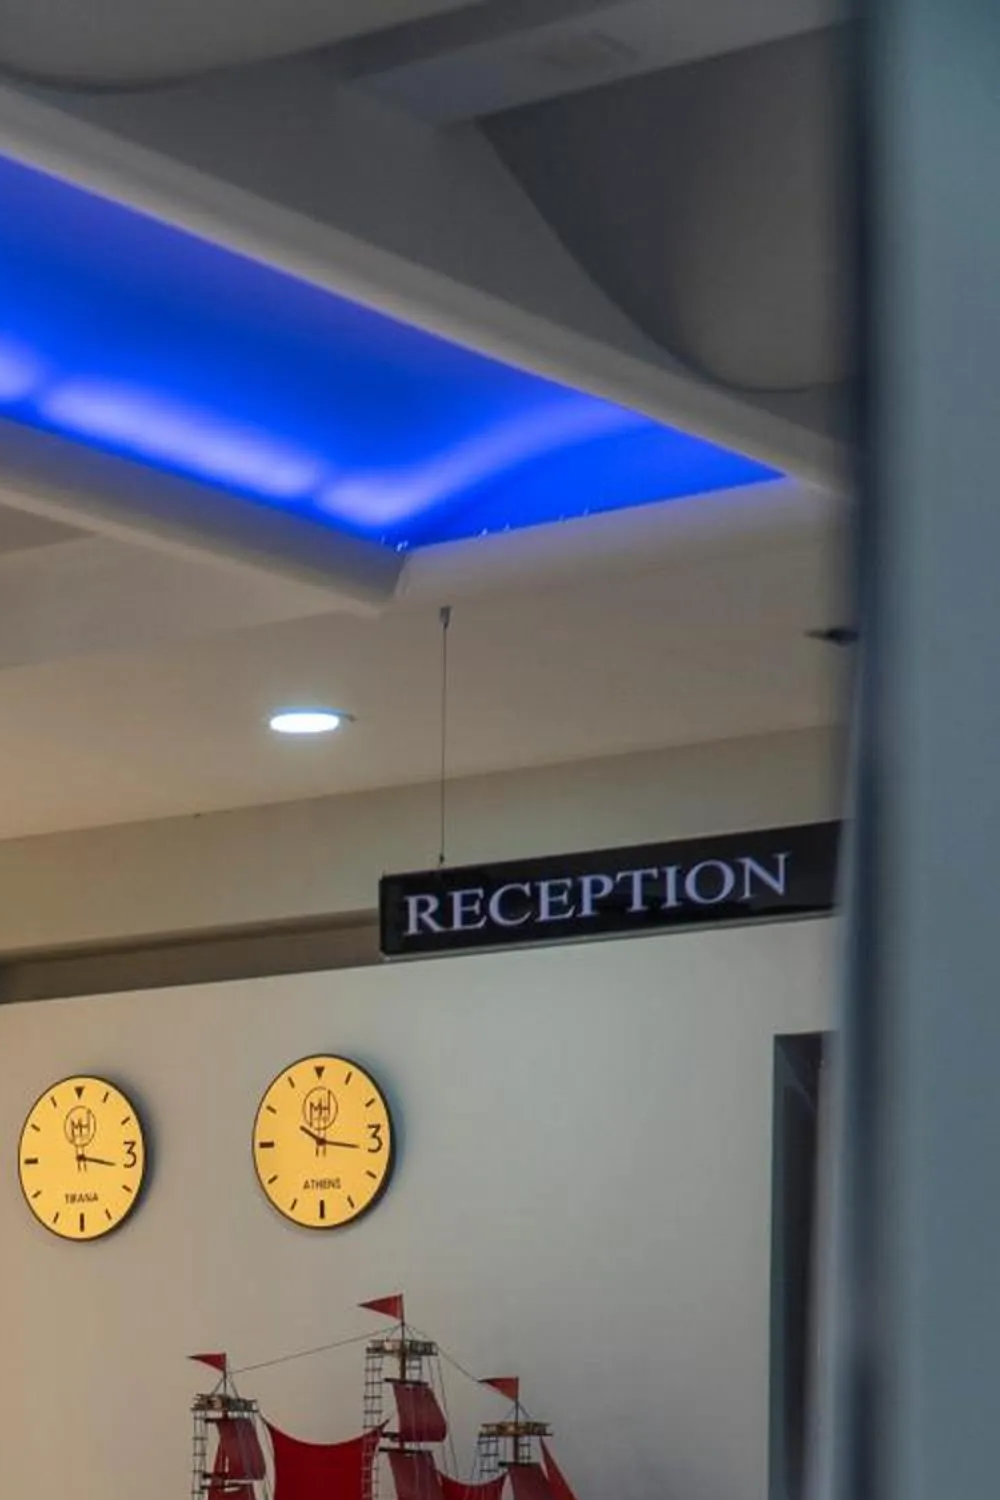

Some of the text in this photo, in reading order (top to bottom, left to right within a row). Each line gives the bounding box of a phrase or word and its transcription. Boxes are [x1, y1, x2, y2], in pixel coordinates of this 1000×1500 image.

[403, 852, 791, 938] RECEPTION
[367, 1123, 383, 1153] 3
[123, 1141, 137, 1168] 3
[302, 1177, 342, 1190] ATHENS
